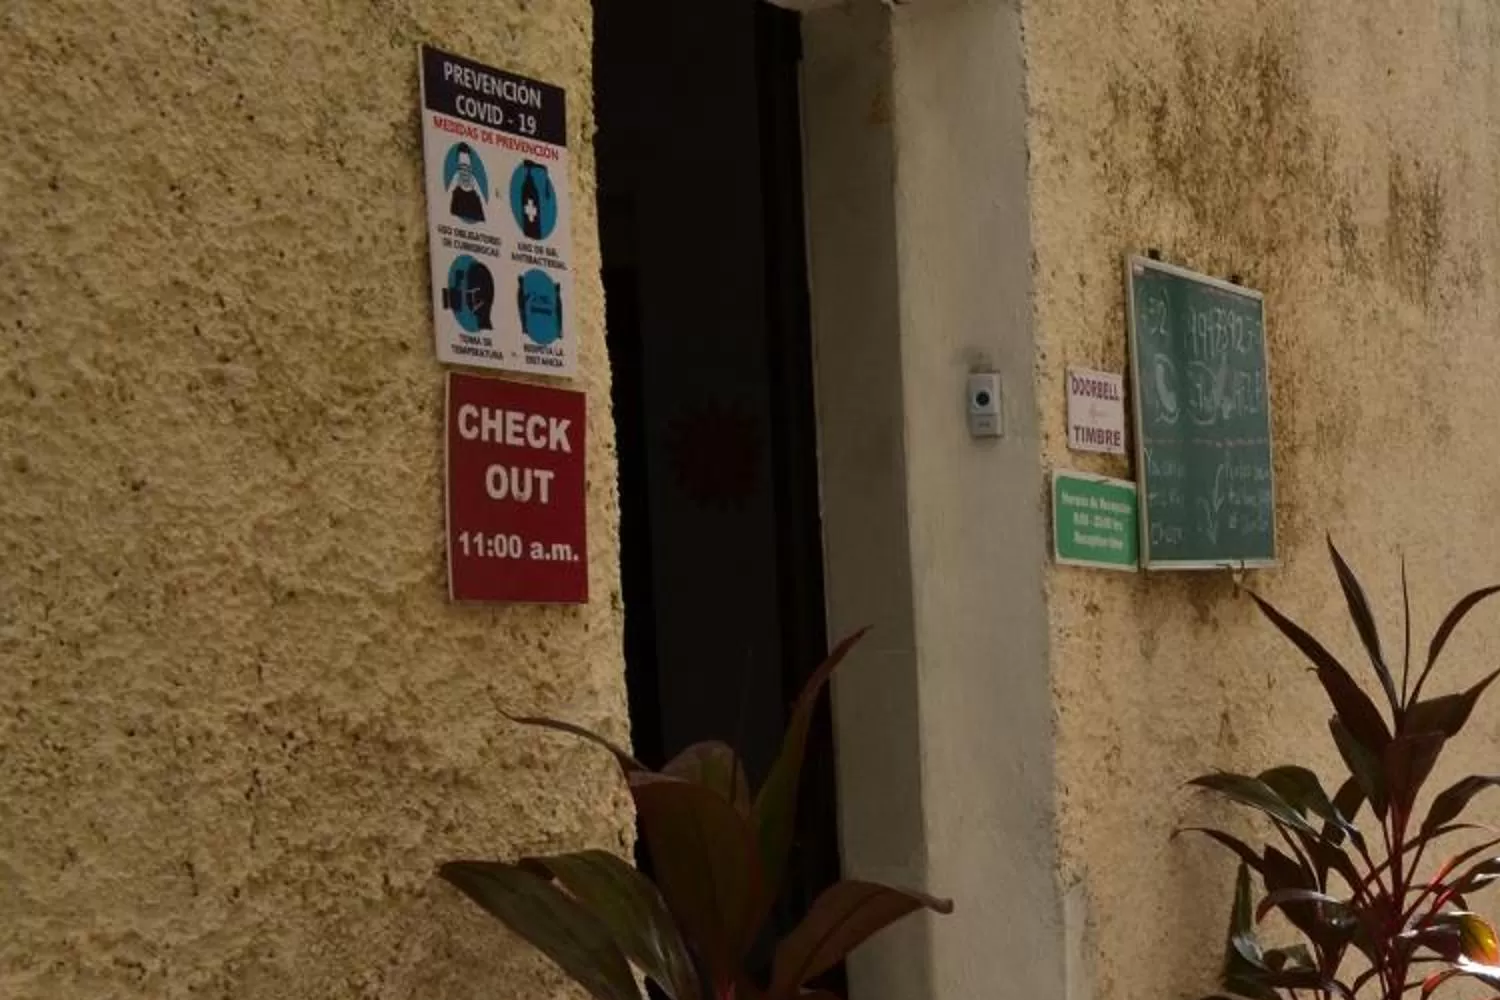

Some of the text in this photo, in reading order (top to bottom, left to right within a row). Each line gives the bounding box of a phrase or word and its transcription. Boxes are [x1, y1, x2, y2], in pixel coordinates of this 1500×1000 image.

[443, 61, 541, 109] PREVENCIÓN
[432, 116, 480, 141] MEDIDAS
[455, 95, 503, 125] COVID
[519, 113, 537, 135] 19
[1072, 376, 1120, 401] DOORBELL
[457, 403, 572, 453] CHECK
[1073, 425, 1121, 446] TIMBRE
[485, 464, 554, 504] OUT
[458, 531, 579, 561] 11:00 a.m.
